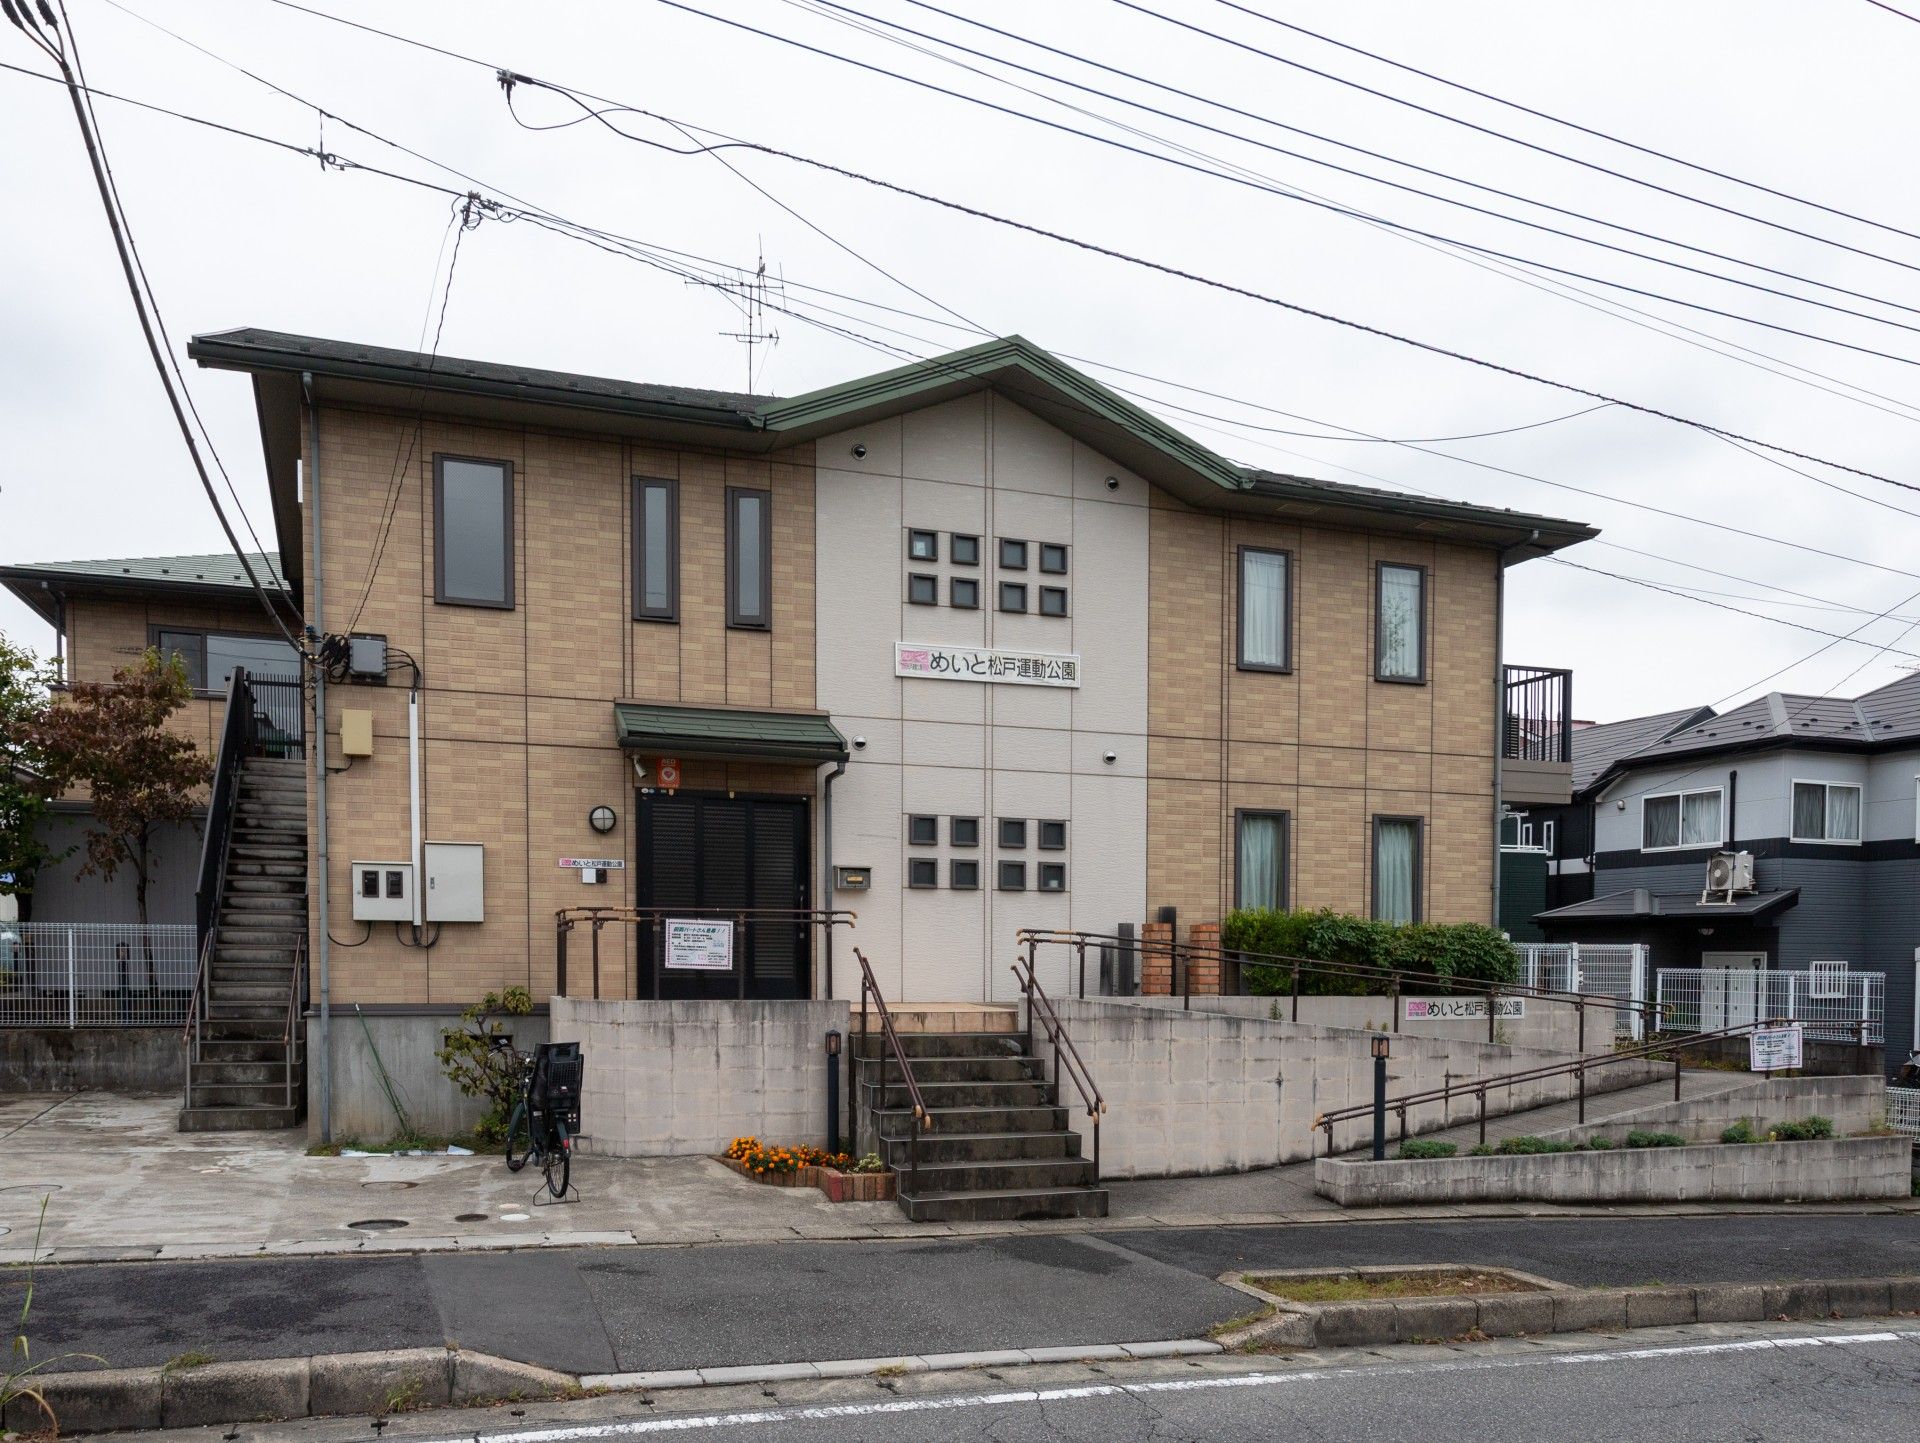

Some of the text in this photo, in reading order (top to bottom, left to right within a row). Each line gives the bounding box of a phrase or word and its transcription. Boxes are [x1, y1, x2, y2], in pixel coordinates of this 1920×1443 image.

[930, 652, 1075, 681] めいと松戸運動公園
